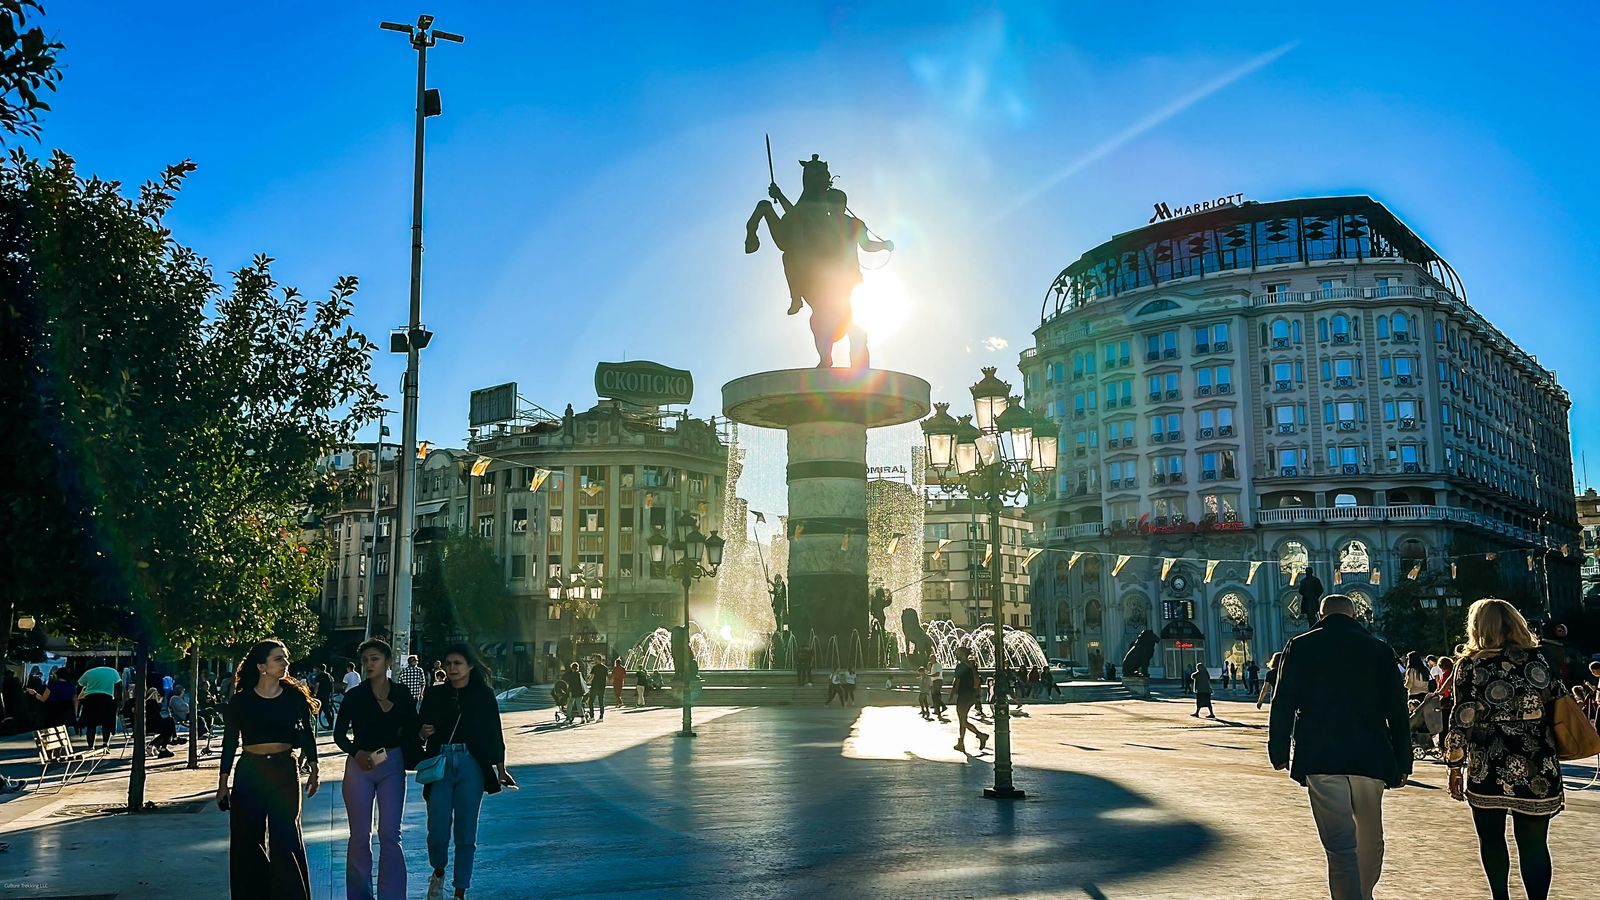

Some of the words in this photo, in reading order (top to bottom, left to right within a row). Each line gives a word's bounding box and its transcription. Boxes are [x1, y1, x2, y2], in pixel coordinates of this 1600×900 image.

[1174, 193, 1244, 217] MARRIOTT
[603, 370, 688, 396] СКОПСКО
[866, 465, 908, 474] MIRAL
